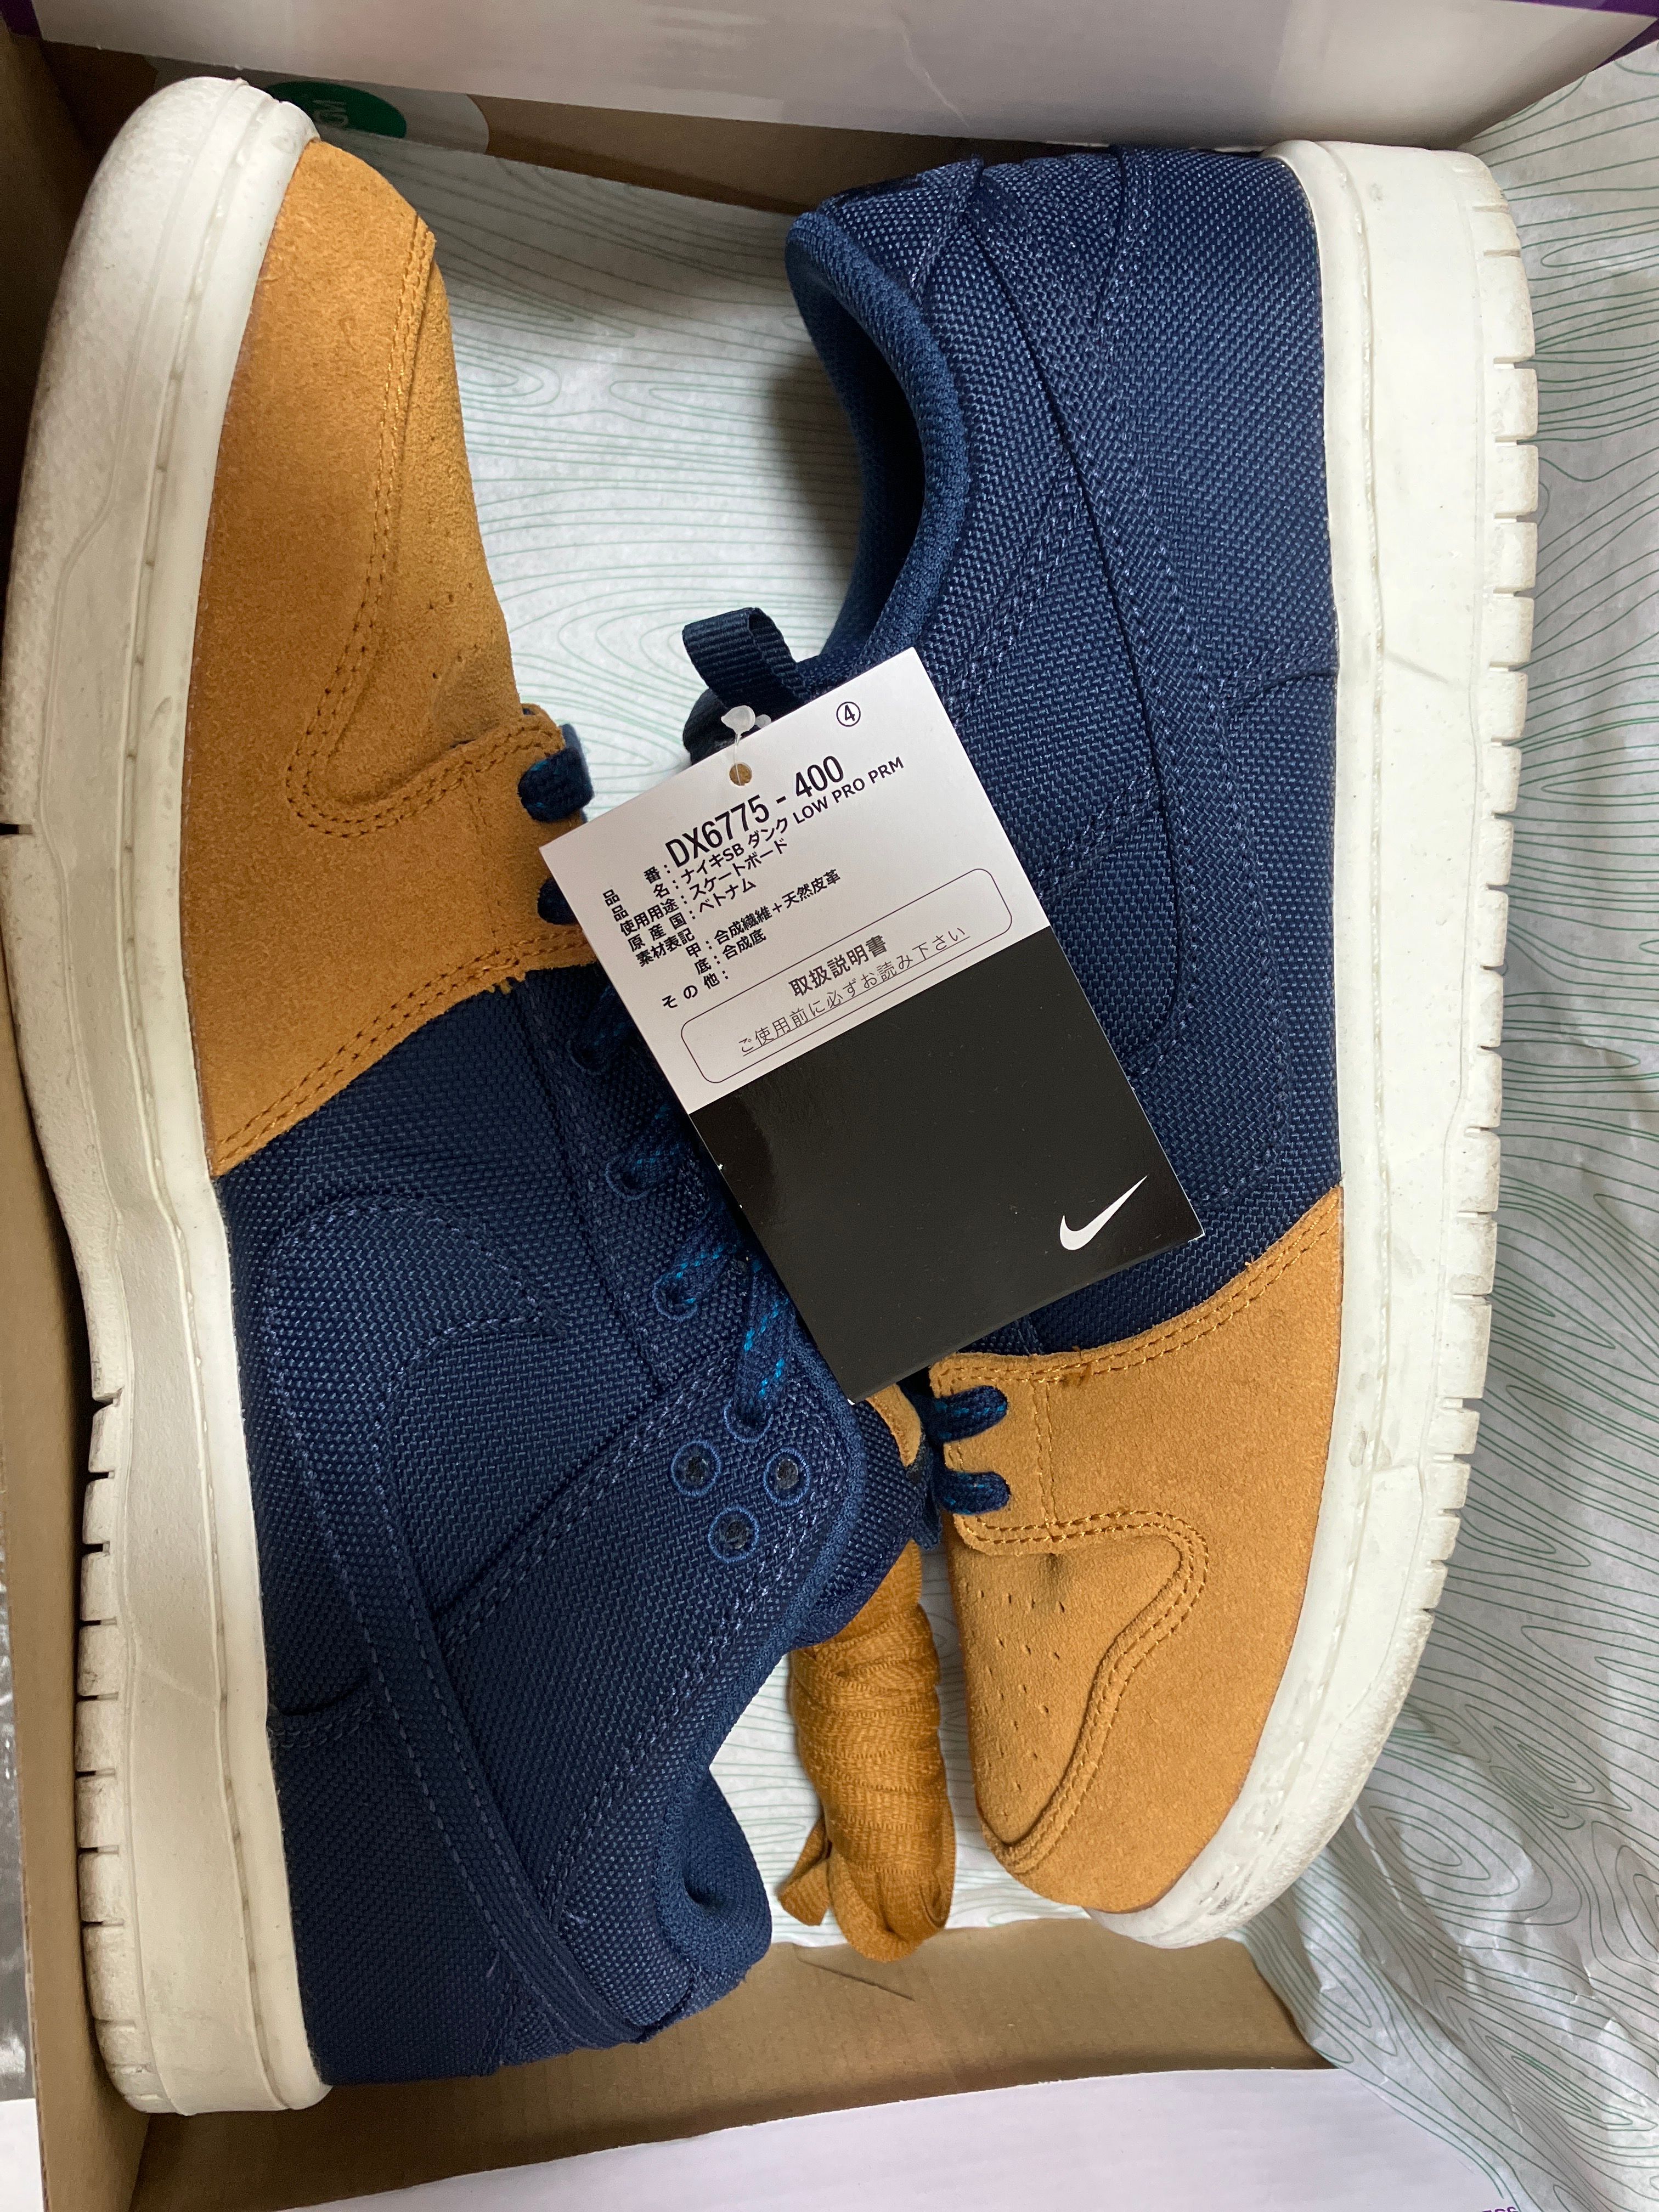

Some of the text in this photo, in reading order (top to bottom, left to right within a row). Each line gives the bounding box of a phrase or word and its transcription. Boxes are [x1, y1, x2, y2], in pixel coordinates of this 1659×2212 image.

[664, 793, 770, 869] DX6775
[795, 755, 844, 798] 400
[792, 795, 829, 825] LOW
[831, 777, 866, 804] PRO
[867, 756, 905, 785] PRM
[635, 927, 696, 968] 素材表記
[787, 934, 888, 997] 取扱説明書
